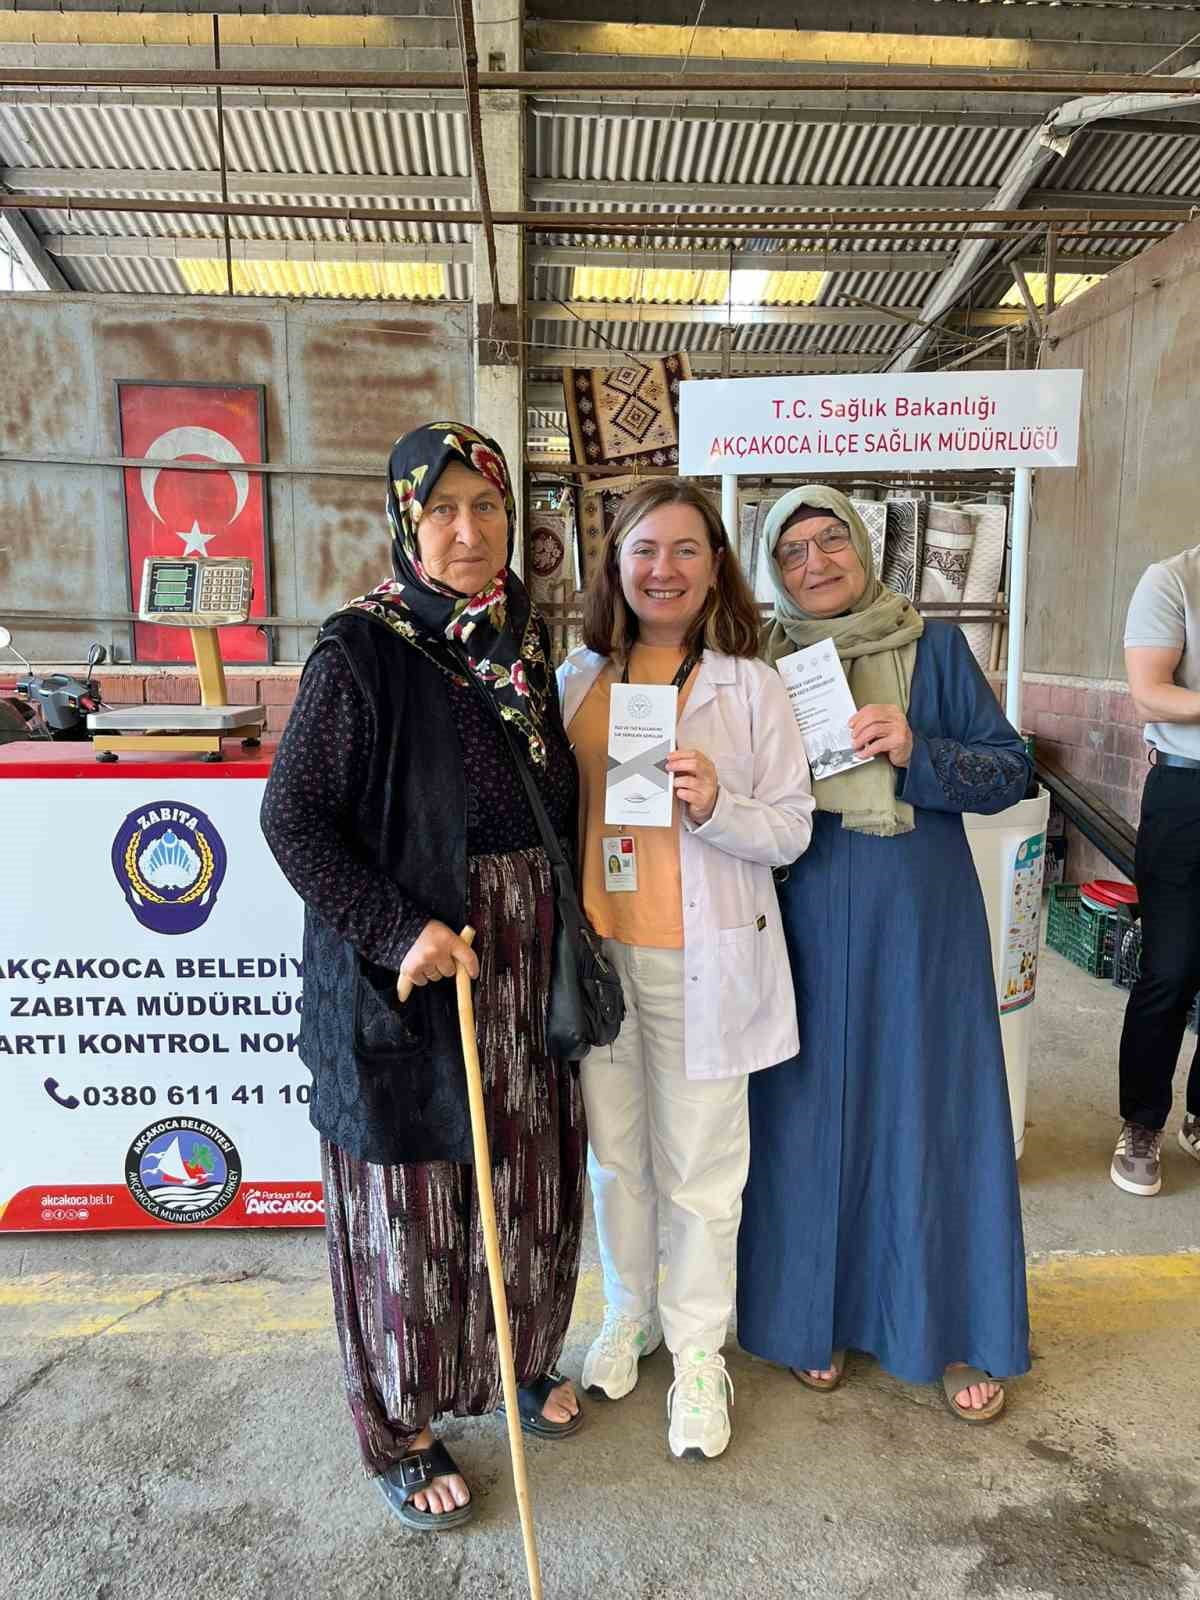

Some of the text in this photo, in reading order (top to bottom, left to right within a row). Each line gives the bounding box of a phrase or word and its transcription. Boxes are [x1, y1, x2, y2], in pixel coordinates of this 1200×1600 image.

[772, 395, 995, 422] T.C. Sağlık Bakanlığı
[710, 426, 1058, 457] AKÇAKOCA İLÇE SAĞLIK MÜDÜRLÜĞÜ
[136, 808, 199, 830] ZABITA
[10, 996, 127, 1017] ZABITA
[78, 1033, 229, 1054] KONTROL
[83, 1084, 311, 1106] 0380 611 41 10
[133, 1119, 235, 1154] AKÇAKOCA BELEDİYESİ
[128, 1171, 160, 1215] AKÇAKOCA
